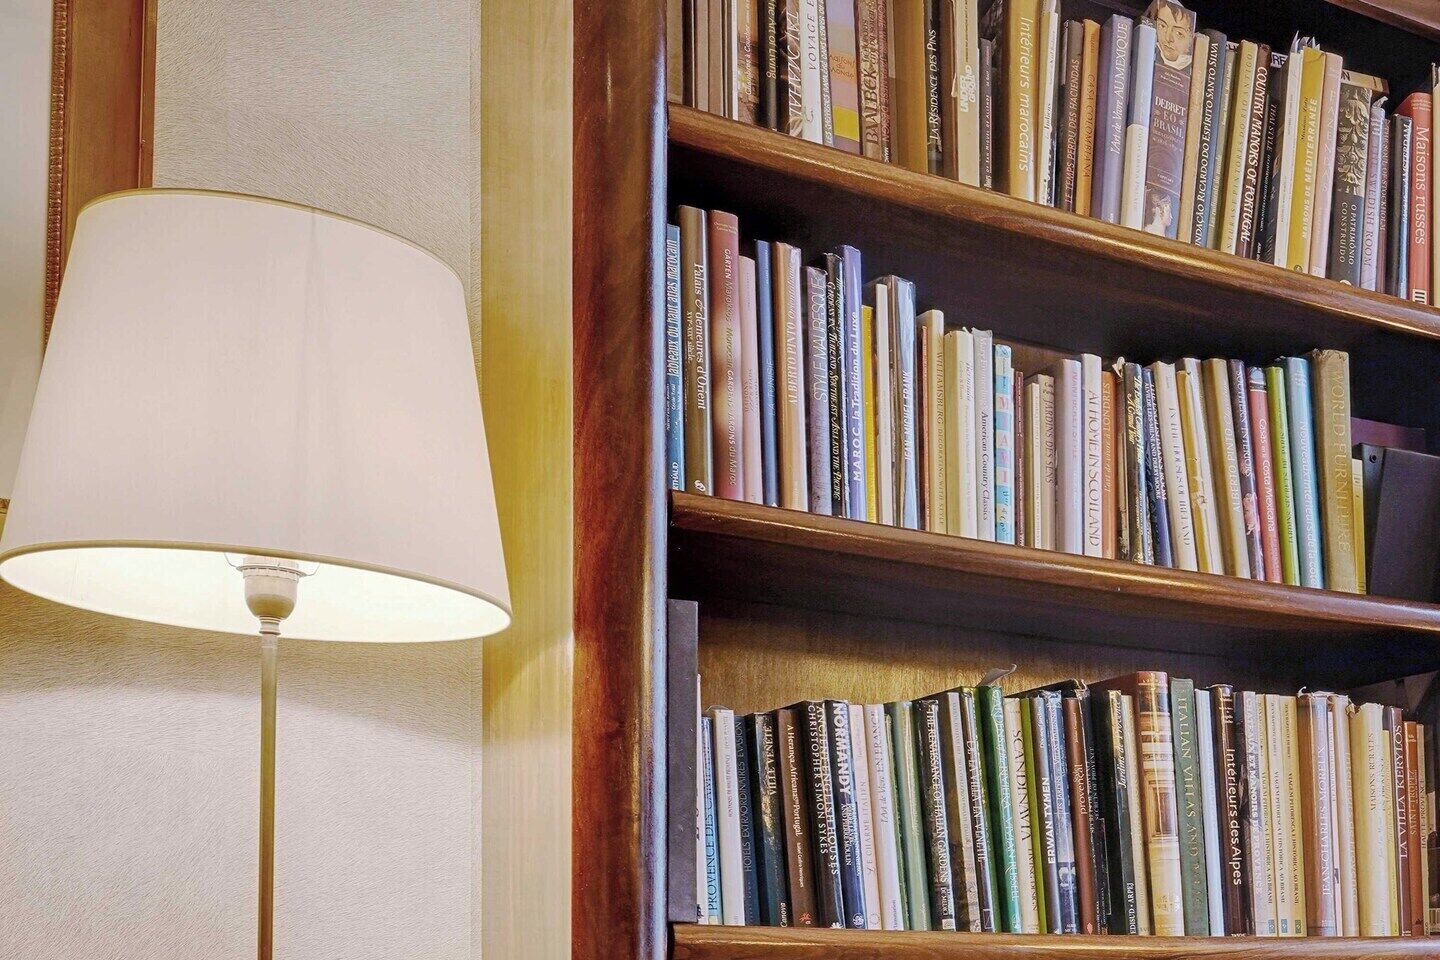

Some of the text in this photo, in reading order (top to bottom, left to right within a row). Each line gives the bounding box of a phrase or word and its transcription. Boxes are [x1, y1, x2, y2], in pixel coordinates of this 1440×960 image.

[785, 10, 802, 117] TAJ MAHAL
[805, 13, 818, 71] VOYAGE
[960, 75, 968, 113] UNDER
[965, 65, 975, 102] GROUND
[1019, 17, 1033, 171] Intérieurs marocains
[1069, 59, 1080, 109] HACIENDAS
[1155, 96, 1186, 117] DEBRET
[1066, 130, 1076, 159] PERDU
[1068, 112, 1077, 128] DES
[1083, 74, 1096, 178] CASA COLOMBIANA
[1064, 163, 1074, 190] TEMPS
[1240, 66, 1268, 243] COUNTRY MANORS OF PORTUGAL
[1301, 98, 1318, 238] MAISONS DE MÉDITERRANÉE
[1414, 126, 1430, 190] Maisons
[1414, 196, 1427, 244] russes
[693, 263, 708, 409] Palais & demeures d'Orient
[786, 322, 799, 404] ALBERTO PINTO
[812, 363, 829, 402] STYLE
[1331, 371, 1346, 435] WORLD
[980, 412, 989, 452] American
[1043, 400, 1055, 484] JARDINS DES SENS
[980, 453, 990, 487] Country
[1224, 428, 1240, 512] ALBERTO PINTO
[982, 490, 990, 521] Classics
[831, 703, 852, 795] NORMANDY
[1176, 698, 1192, 758] ITALIAN
[807, 705, 828, 854] CHRISTOPHER SIMON SYKES
[1074, 764, 1088, 814] provençal
[1182, 766, 1196, 817] VILLAS
[1367, 732, 1377, 811] MAISONS RURALES
[1394, 725, 1408, 858] LA VILLA KERYLOS
[704, 814, 714, 837] DES
[1041, 777, 1056, 864] ERWAN TYMEN
[1187, 825, 1199, 856] AND
[1225, 748, 1244, 885] Intérieurs des Alpes
[705, 841, 718, 910] PROVENCE
[778, 902, 788, 927] Canova
